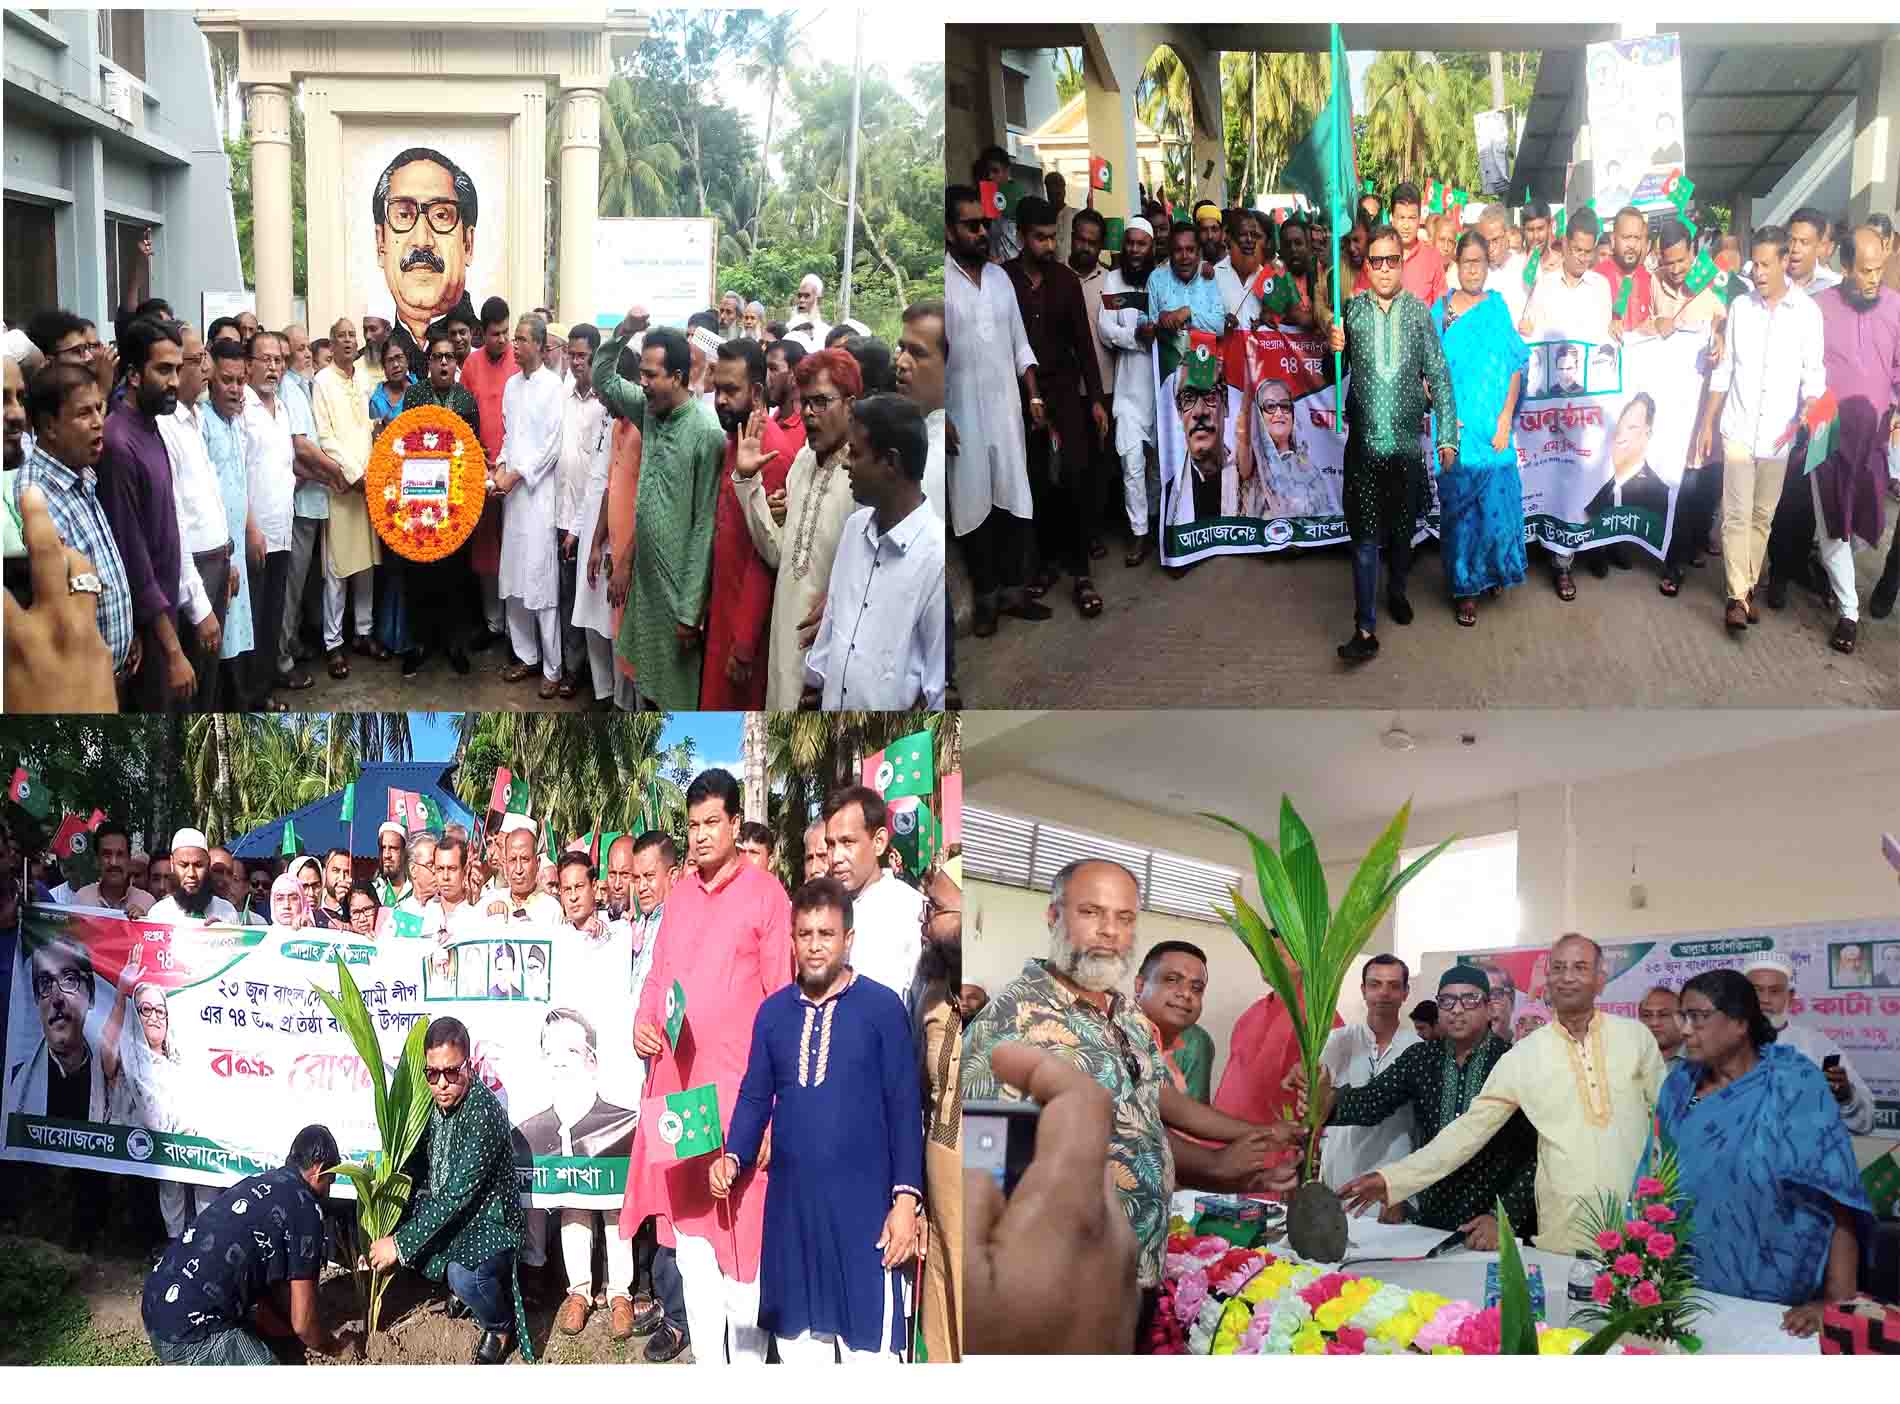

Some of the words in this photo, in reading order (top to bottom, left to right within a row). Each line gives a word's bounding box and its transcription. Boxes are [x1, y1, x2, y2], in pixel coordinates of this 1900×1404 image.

[1280, 356, 1297, 374] ৭৪
[1303, 357, 1323, 376] বছ
[1519, 402, 1602, 432] অনুষ্ঠান
[1177, 525, 1257, 549] আয়োজনেঃ
[1601, 512, 1641, 532] শাখা
[156, 949, 174, 970] ৭৪
[217, 979, 239, 998] ২৩
[245, 980, 270, 1006] জুন
[391, 980, 418, 1002] লীগ
[1809, 991, 1873, 1016] কাটা
[200, 1005, 223, 1026] এর
[228, 1007, 247, 1027] ৭৪
[28, 1123, 116, 1154] আয়োজনেঃ
[163, 1140, 244, 1170] বাংলাদেশ
[554, 1166, 603, 1189] শাখা
